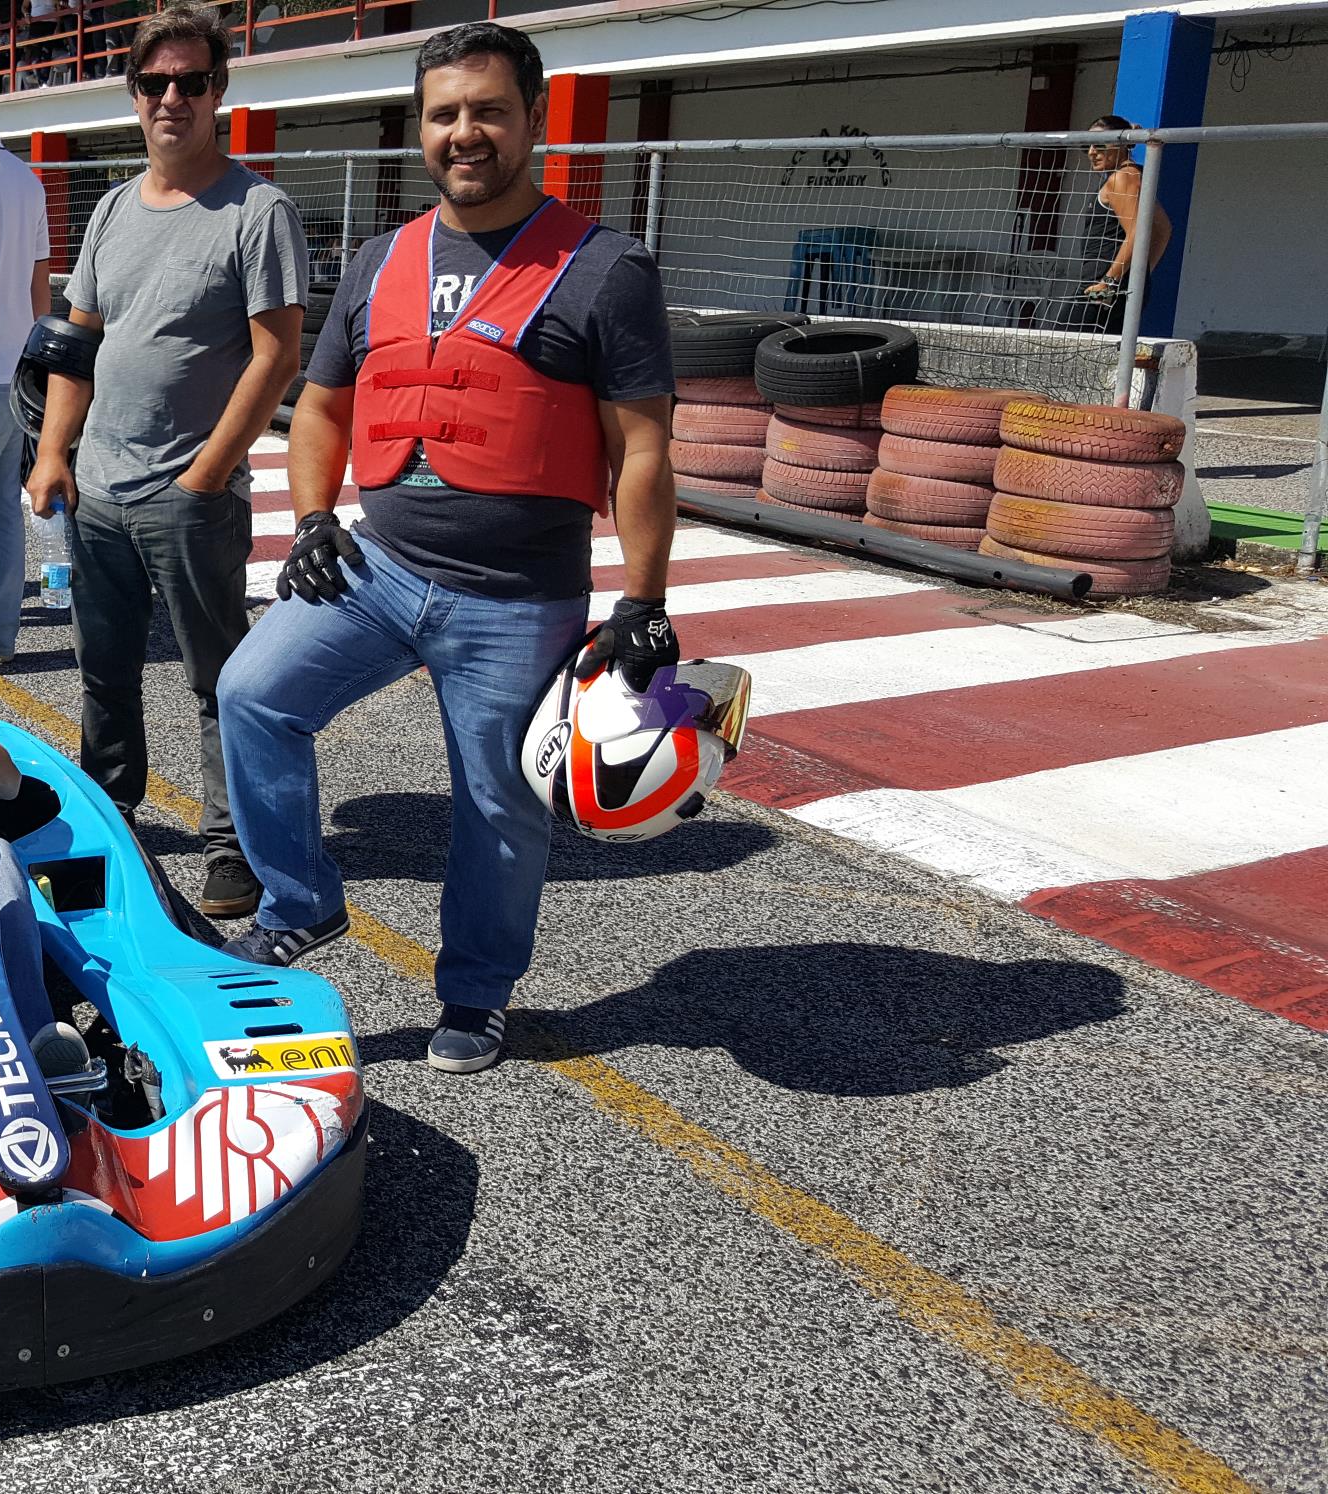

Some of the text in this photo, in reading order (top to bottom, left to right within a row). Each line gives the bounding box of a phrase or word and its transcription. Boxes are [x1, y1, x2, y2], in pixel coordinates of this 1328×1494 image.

[469, 320, 501, 337] sparco
[539, 722, 564, 774] Arai
[281, 1036, 354, 1071] eni
